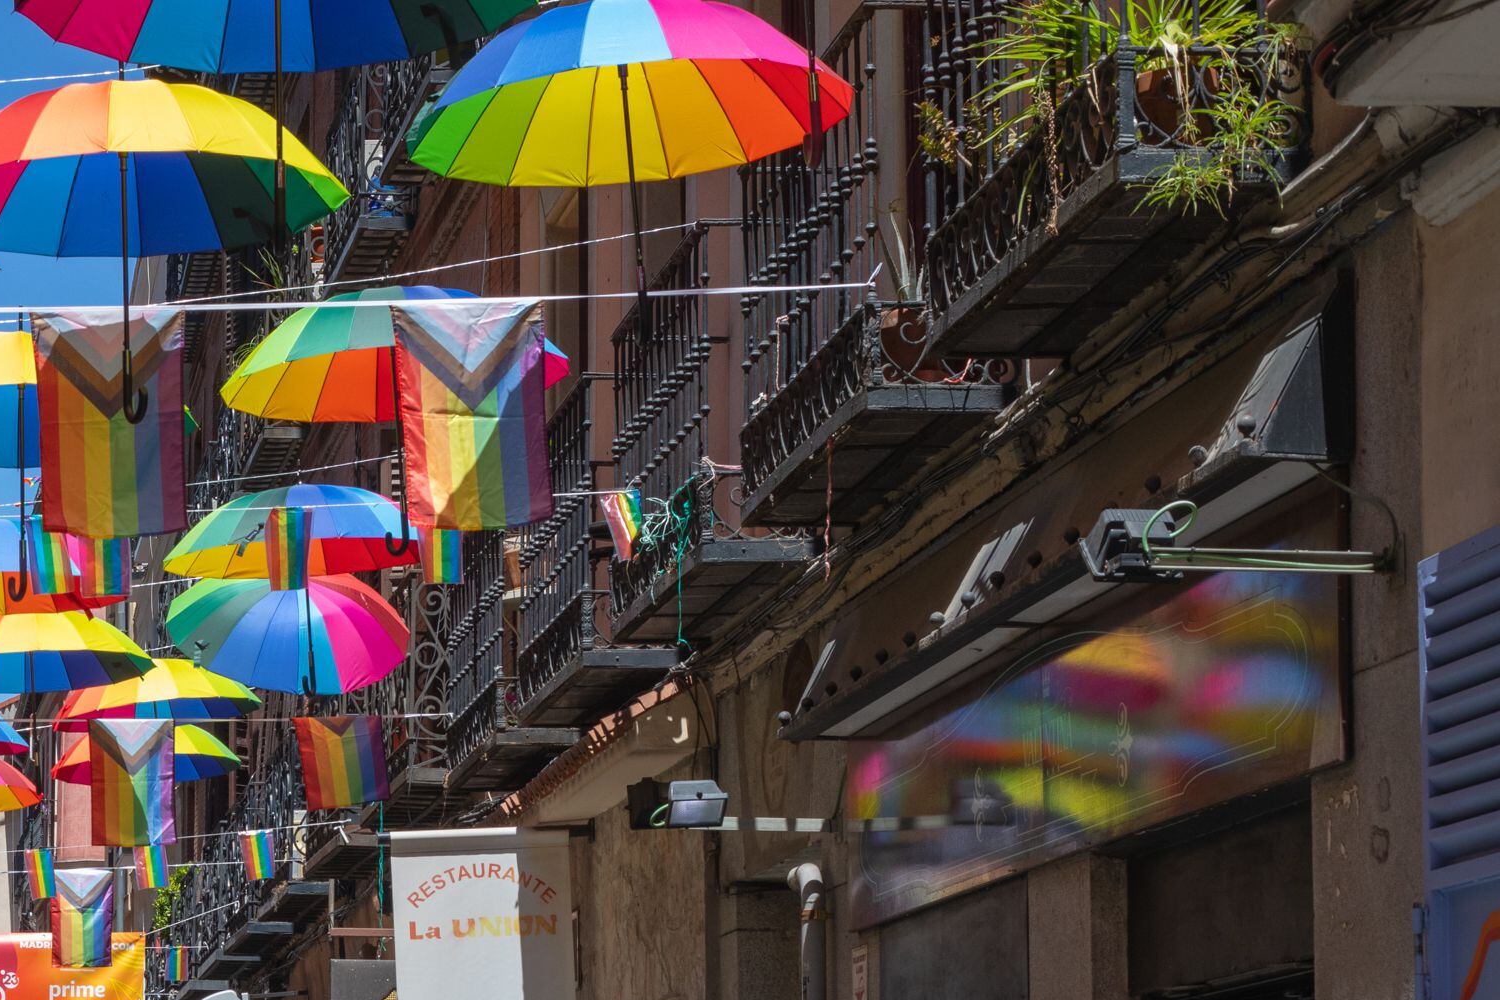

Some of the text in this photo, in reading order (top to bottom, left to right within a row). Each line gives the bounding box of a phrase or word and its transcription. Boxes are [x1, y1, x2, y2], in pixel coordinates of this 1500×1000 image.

[407, 862, 558, 910] RESTAURANTE
[408, 913, 559, 941] La UNION
[49, 979, 106, 1000] prime
